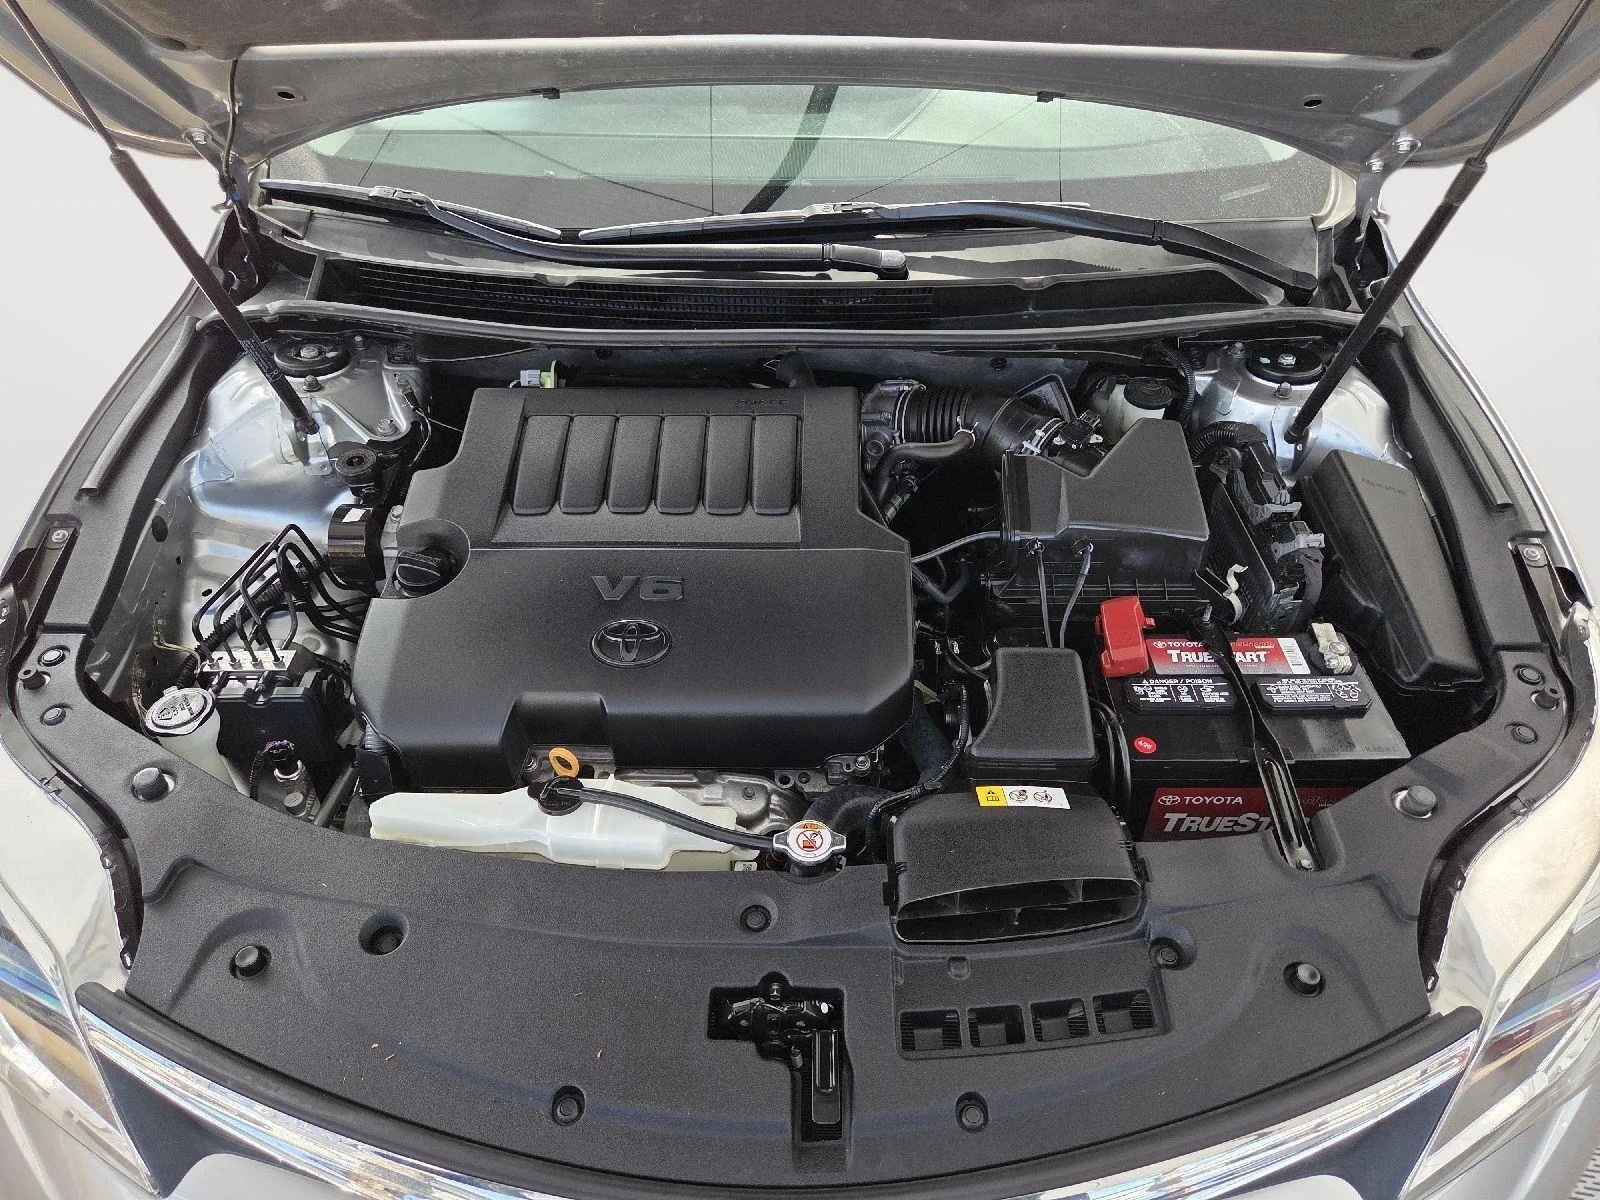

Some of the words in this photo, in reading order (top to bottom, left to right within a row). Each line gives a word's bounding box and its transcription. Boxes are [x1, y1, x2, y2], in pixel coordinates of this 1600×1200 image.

[591, 575, 684, 601] V6
[1166, 649, 1267, 663] TRUEART
[1183, 796, 1243, 805] TOYOTA
